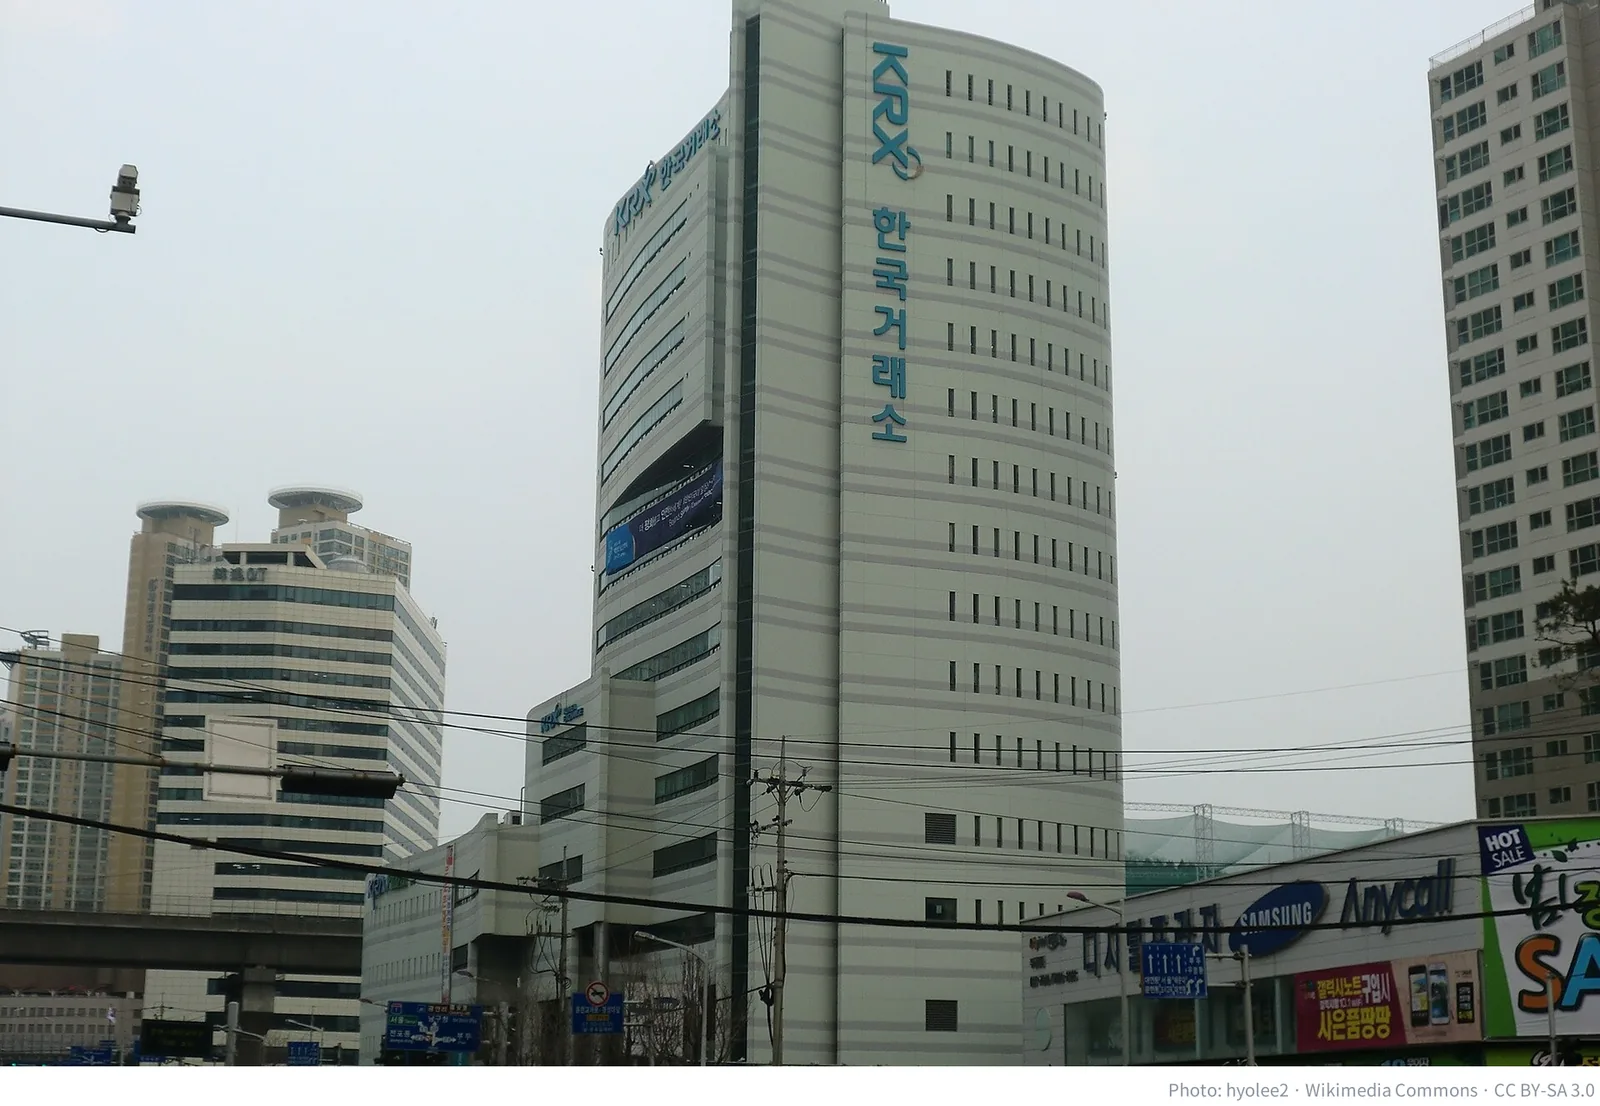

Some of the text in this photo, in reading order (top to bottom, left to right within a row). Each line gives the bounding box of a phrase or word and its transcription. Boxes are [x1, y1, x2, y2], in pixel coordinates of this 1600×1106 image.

[872, 41, 922, 179] KRX
[871, 207, 911, 443] 한국거래소
[1485, 829, 1520, 852] HOT
[1492, 846, 1526, 868] SALE
[1340, 858, 1456, 936] Anycall
[1240, 901, 1313, 936] SAMSUNG
[1317, 973, 1391, 1004] 갤럭시노트 구입시
[1317, 1005, 1391, 1042] 사은품팡팡
